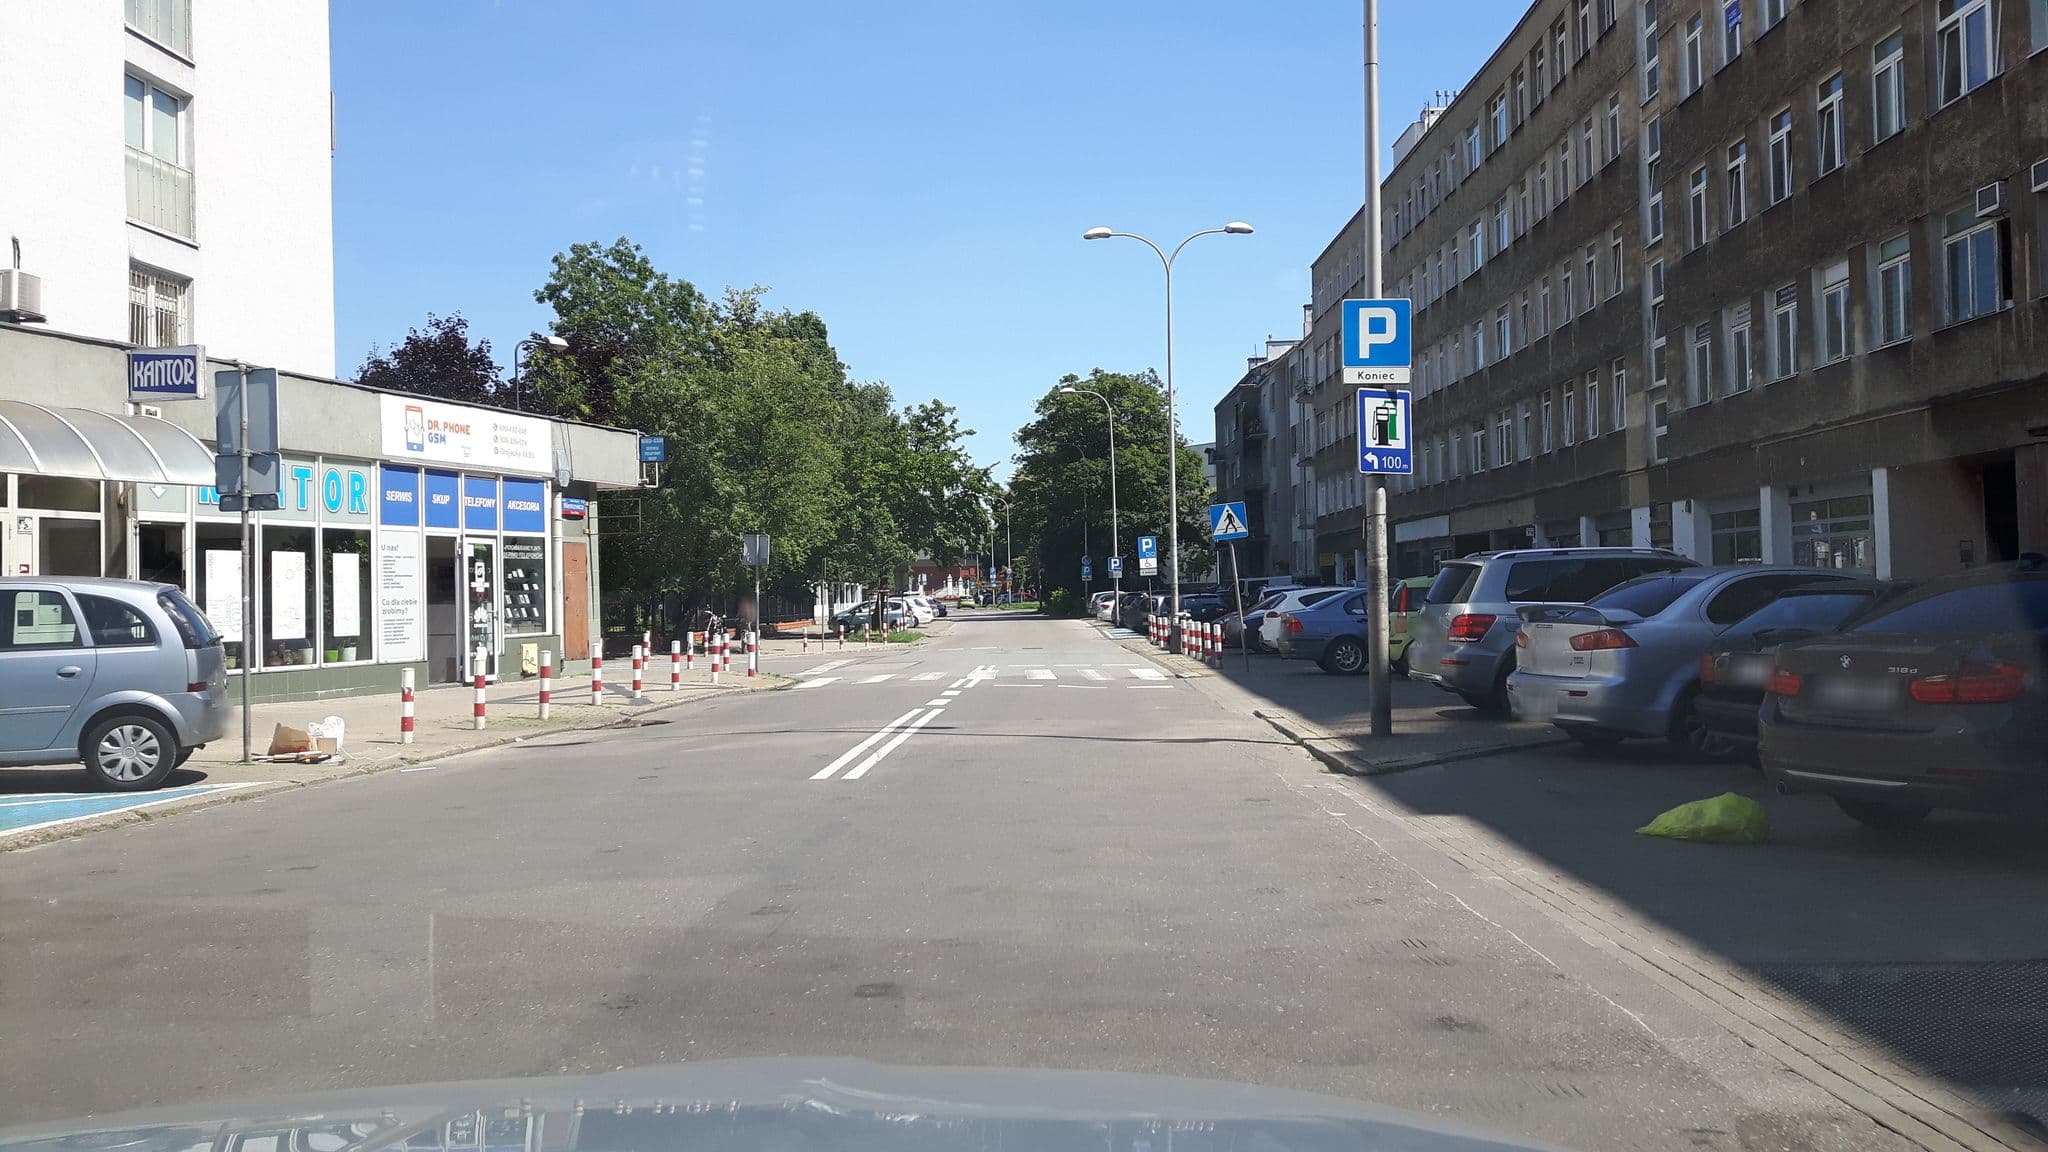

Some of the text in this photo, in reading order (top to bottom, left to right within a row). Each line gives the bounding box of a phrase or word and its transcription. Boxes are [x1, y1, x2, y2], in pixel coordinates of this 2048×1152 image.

[1359, 308, 1396, 358] P
[133, 358, 195, 388] KANTOR
[1358, 371, 1395, 380] Koniec
[428, 419, 471, 435] DR. PHONE
[428, 433, 446, 444] GSM
[1382, 456, 1402, 469] 100
[386, 490, 412, 503] SERWIS
[432, 493, 450, 505] SKUP
[464, 496, 497, 508] TELEFONY
[507, 500, 540, 512] AKCESORIA
[1142, 539, 1152, 552] P
[1111, 559, 1119, 569] P
